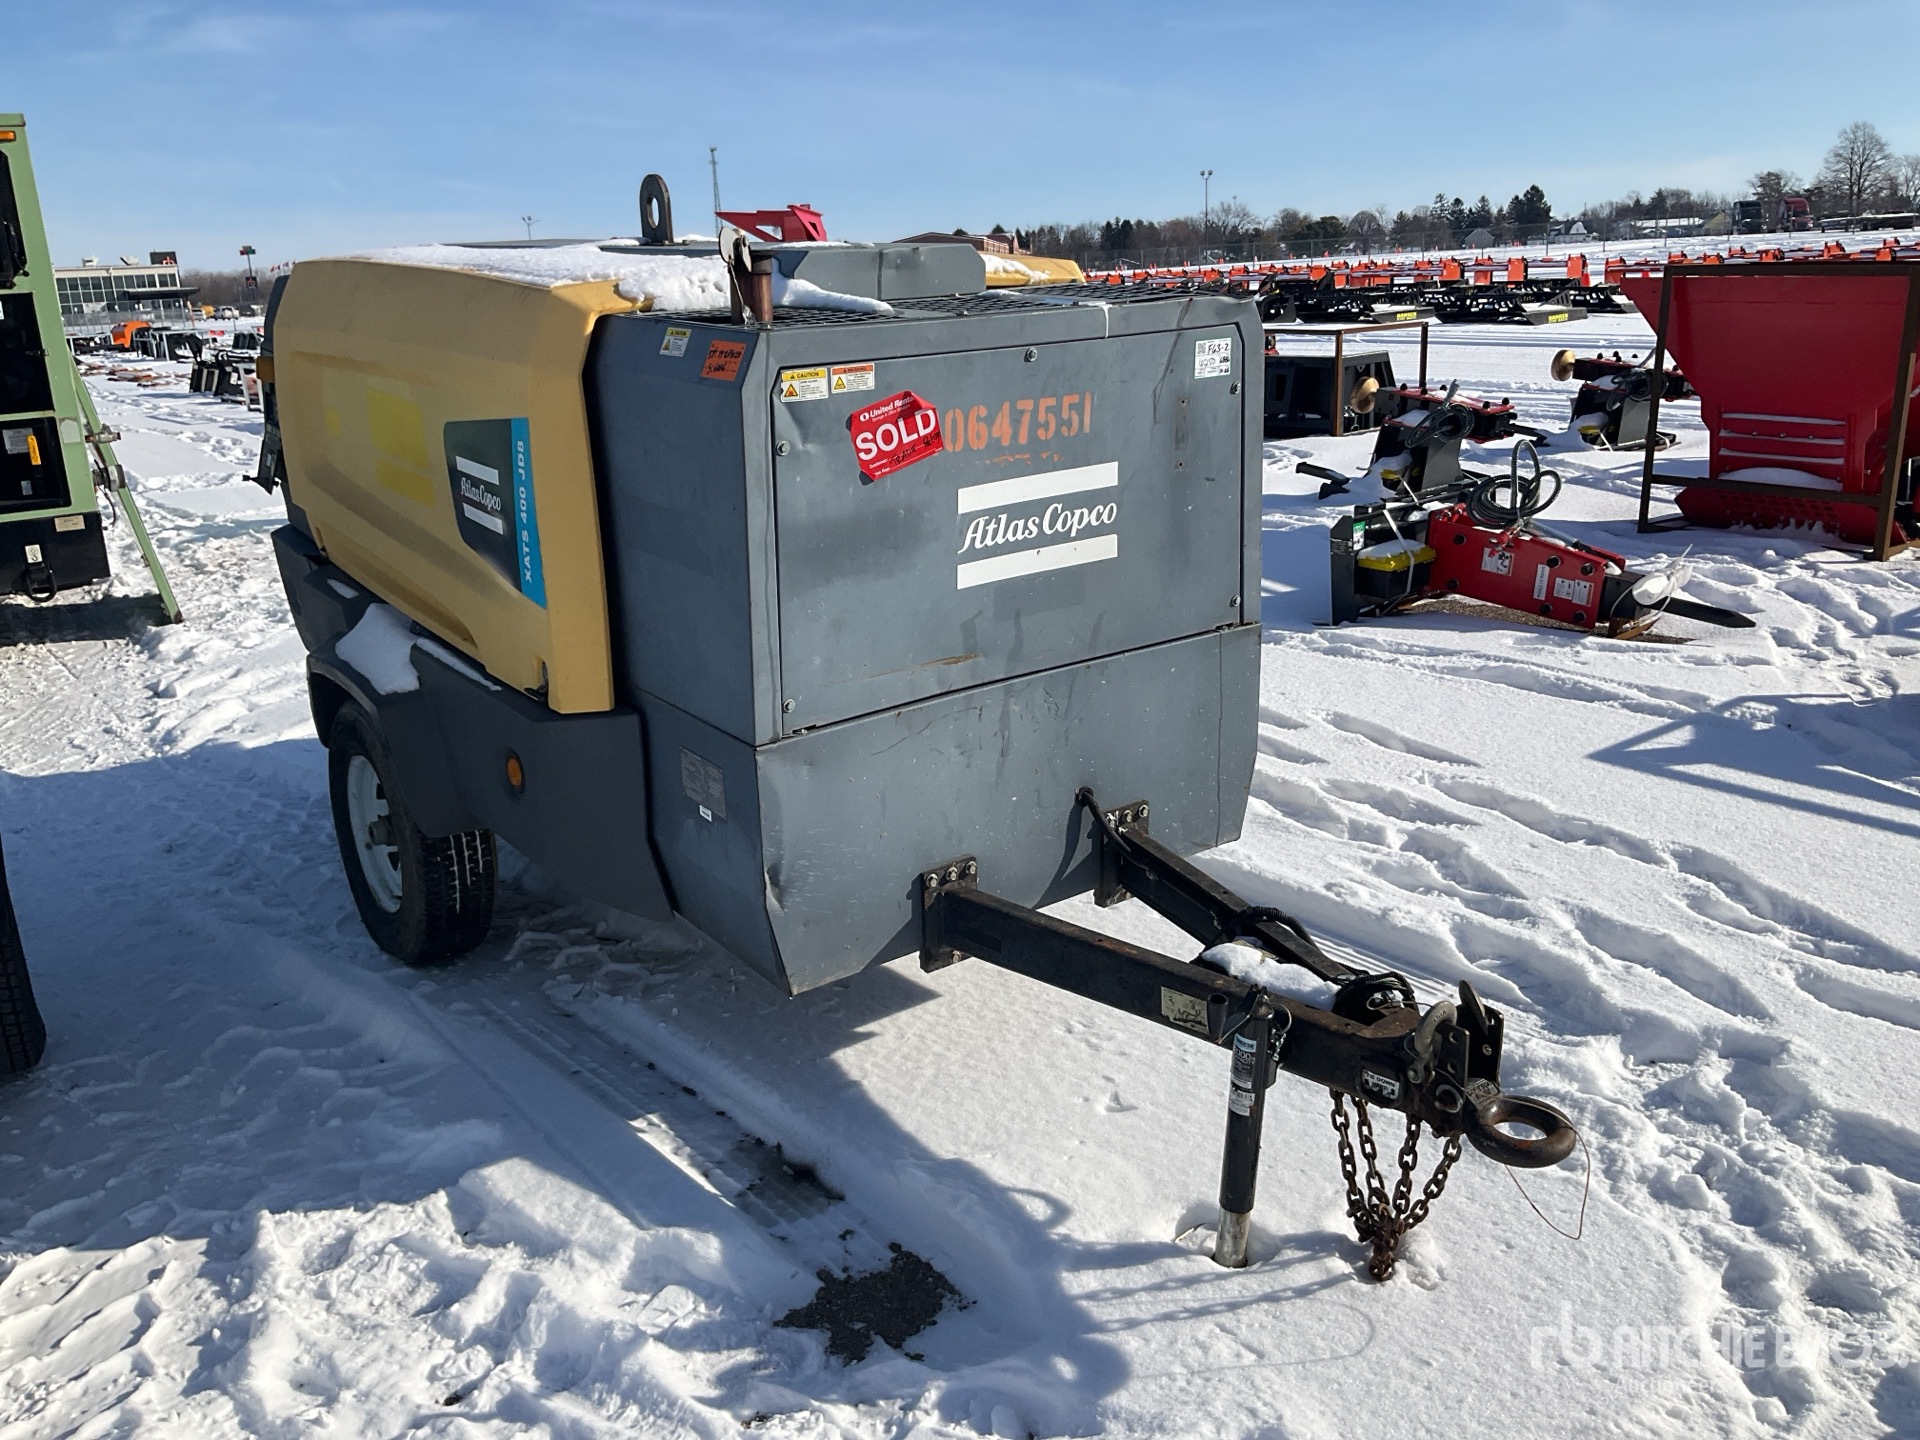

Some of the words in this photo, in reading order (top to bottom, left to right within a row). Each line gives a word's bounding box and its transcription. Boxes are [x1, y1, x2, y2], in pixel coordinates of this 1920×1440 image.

[796, 371, 820, 380] CAUTION
[869, 401, 894, 418] United
[856, 408, 937, 461] SOLD
[461, 477, 480, 503] Atlas
[479, 484, 501, 511] Copco
[518, 486, 528, 525] 400
[957, 513, 1040, 554] Atlas
[1042, 502, 1118, 538] Copco
[521, 529, 533, 583] XATS
